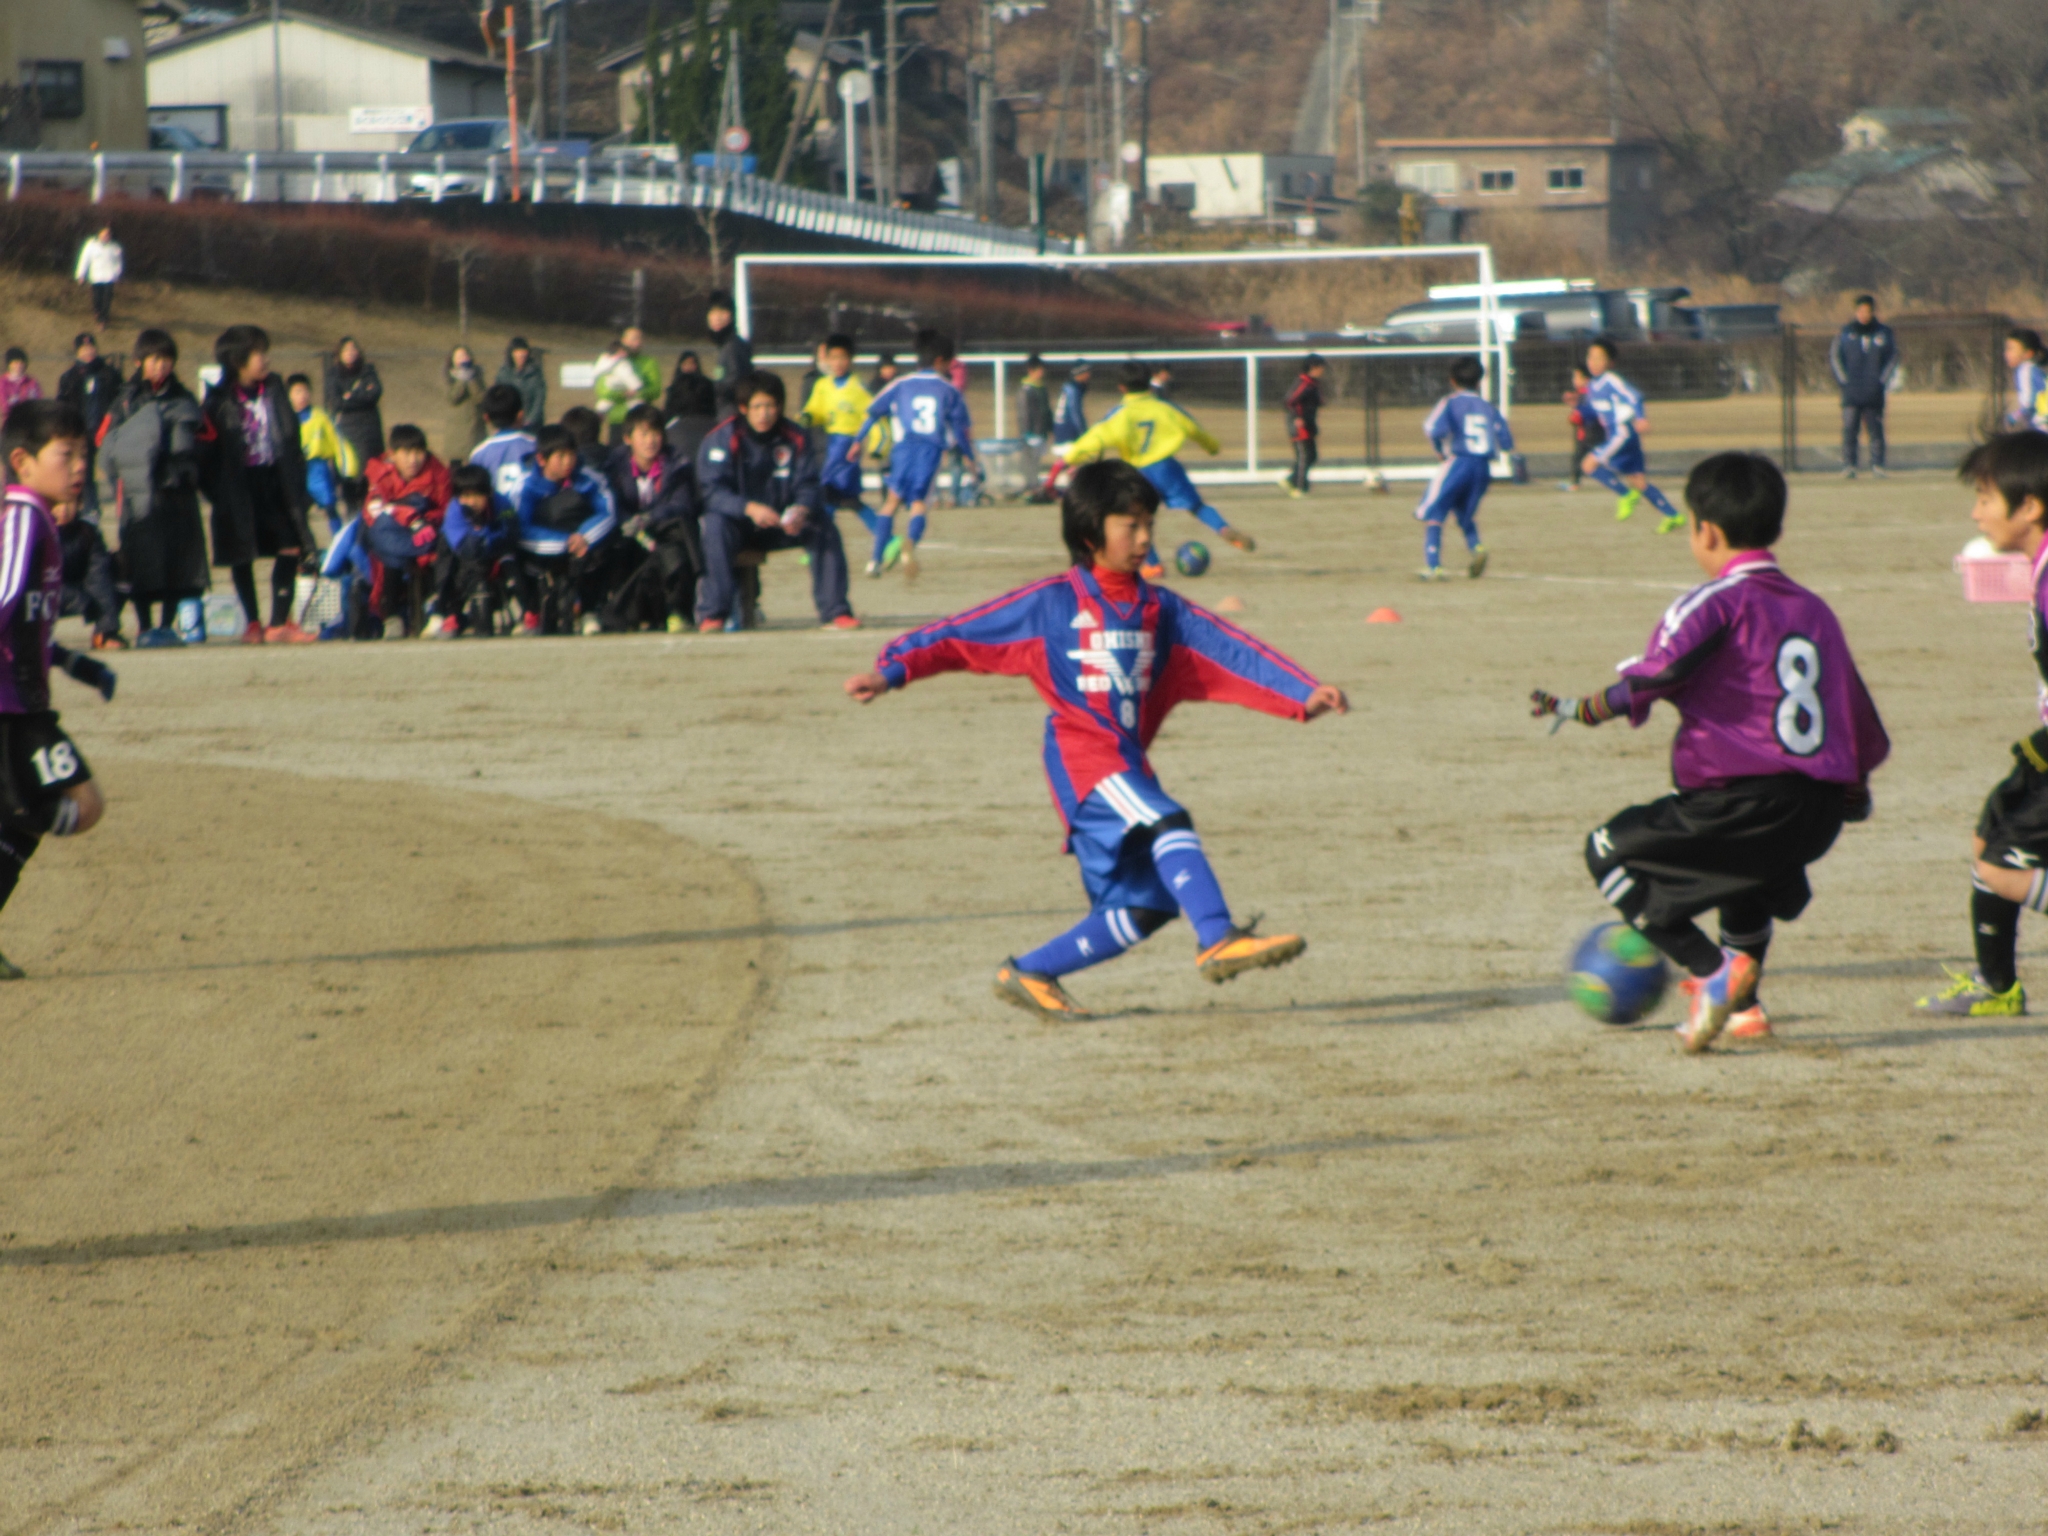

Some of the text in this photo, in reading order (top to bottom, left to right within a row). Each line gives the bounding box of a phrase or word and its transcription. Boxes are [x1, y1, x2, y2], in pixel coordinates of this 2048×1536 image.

[911, 395, 937, 434] 3
[1464, 414, 1489, 454] 5
[1137, 420, 1155, 454] 7
[1775, 636, 1825, 756] 8
